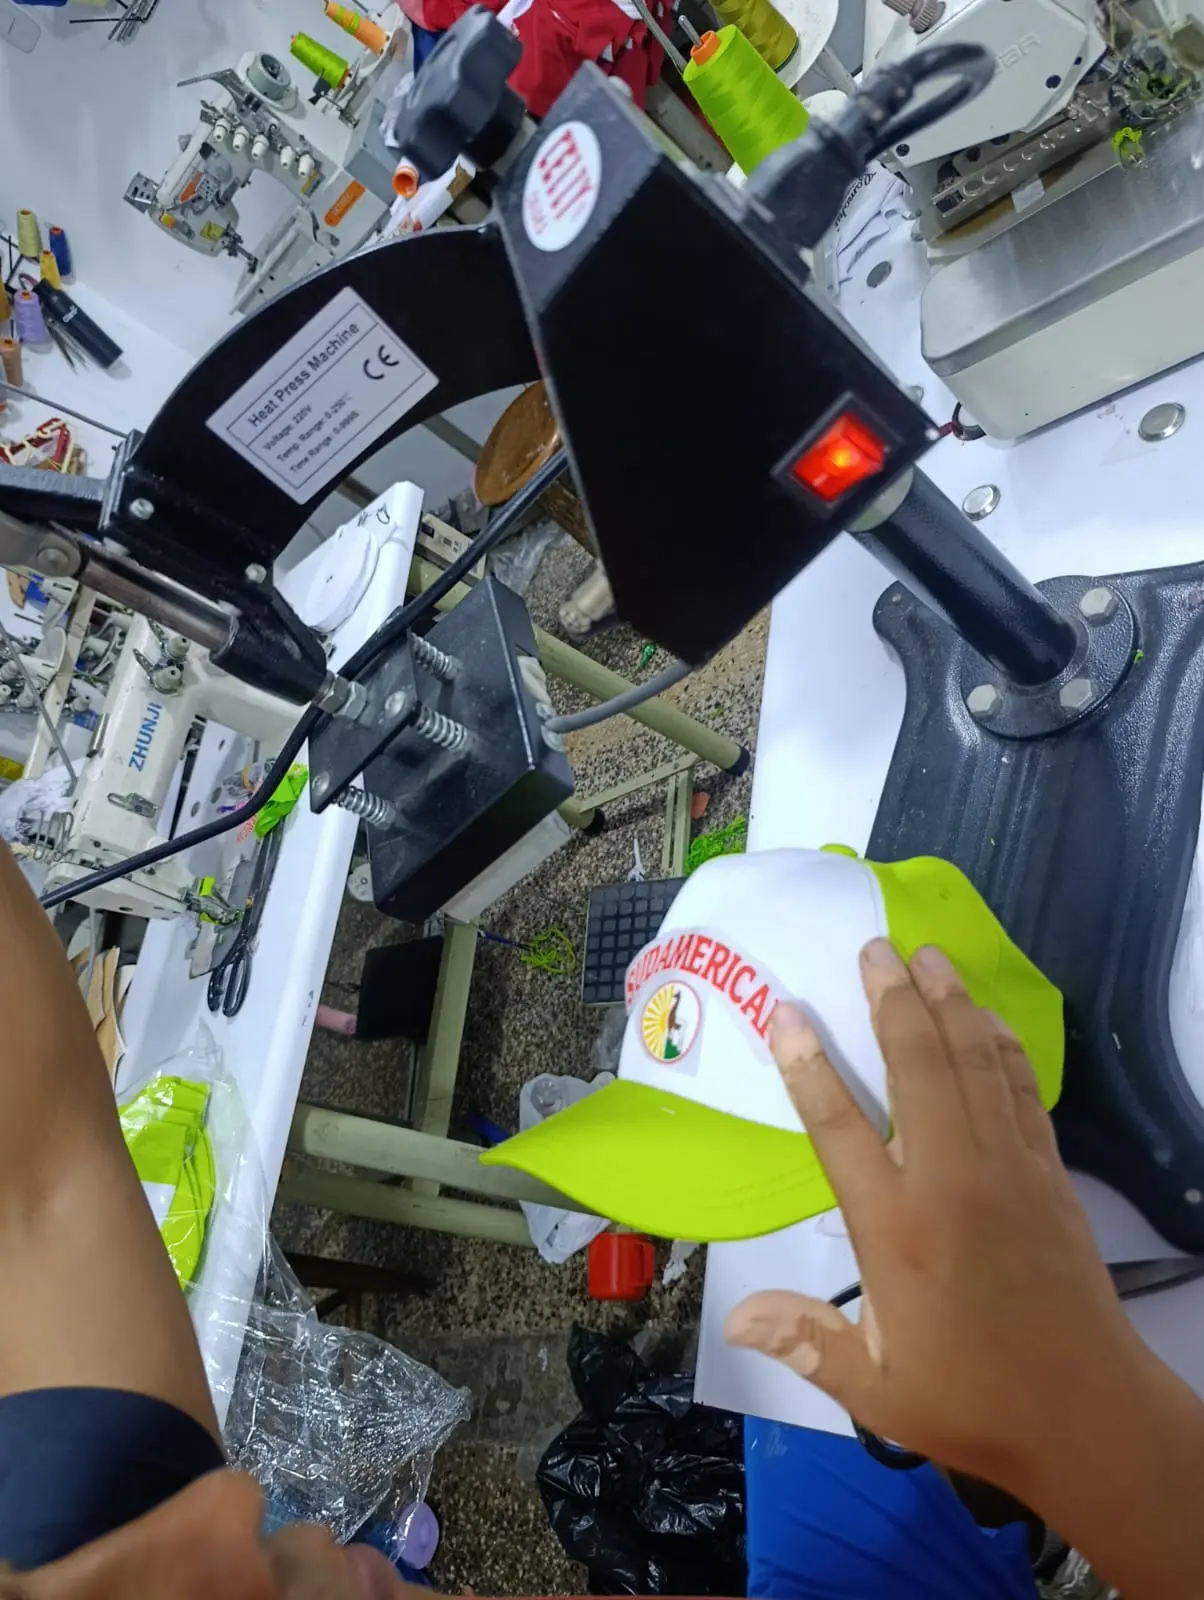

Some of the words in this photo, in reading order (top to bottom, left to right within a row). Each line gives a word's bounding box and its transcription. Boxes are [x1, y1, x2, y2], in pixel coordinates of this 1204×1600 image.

[248, 400, 279, 428] Heat
[274, 370, 311, 402] Press
[307, 323, 359, 371] Machine
[363, 345, 399, 380] CE
[128, 701, 163, 772] ZHUNJI
